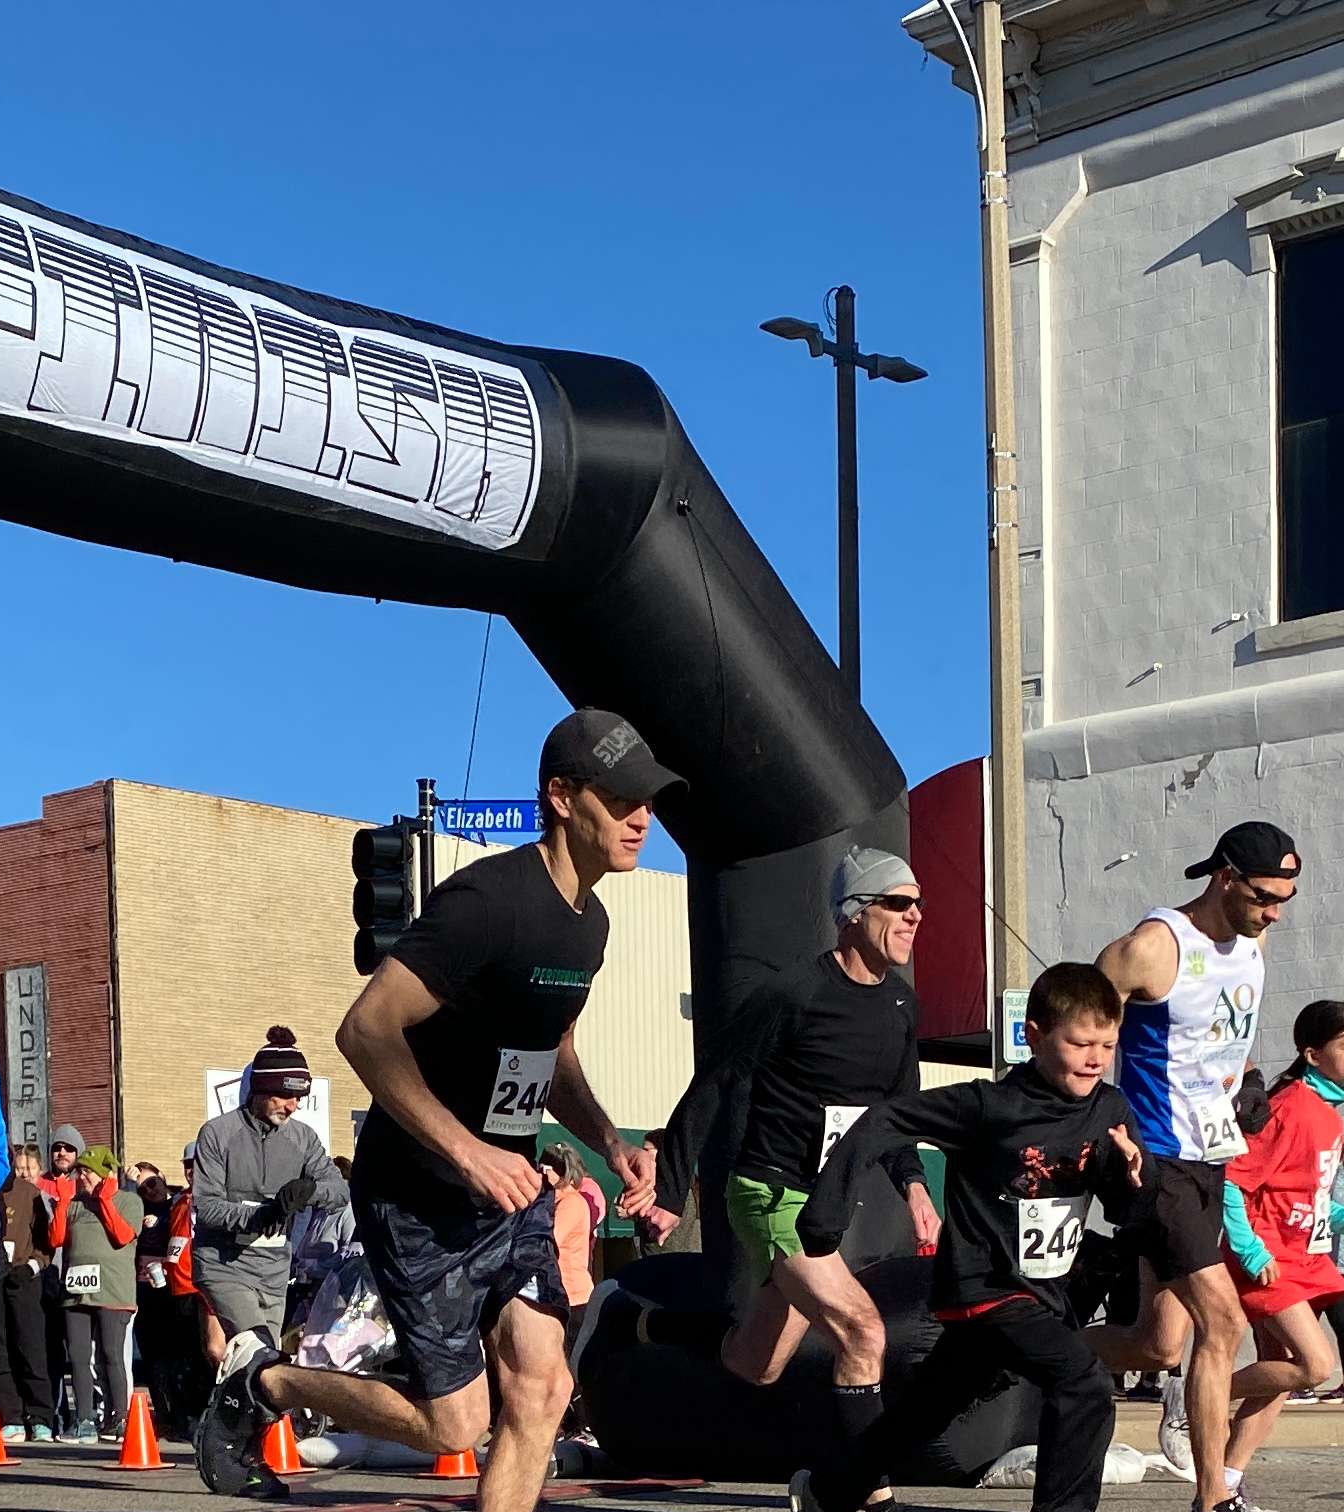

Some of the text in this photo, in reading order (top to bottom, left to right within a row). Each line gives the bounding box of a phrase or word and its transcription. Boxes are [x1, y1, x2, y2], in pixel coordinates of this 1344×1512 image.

[446, 807, 523, 829] Elizabeth
[1204, 1118, 1238, 1149] 24
[66, 1274, 98, 1288] 2400
